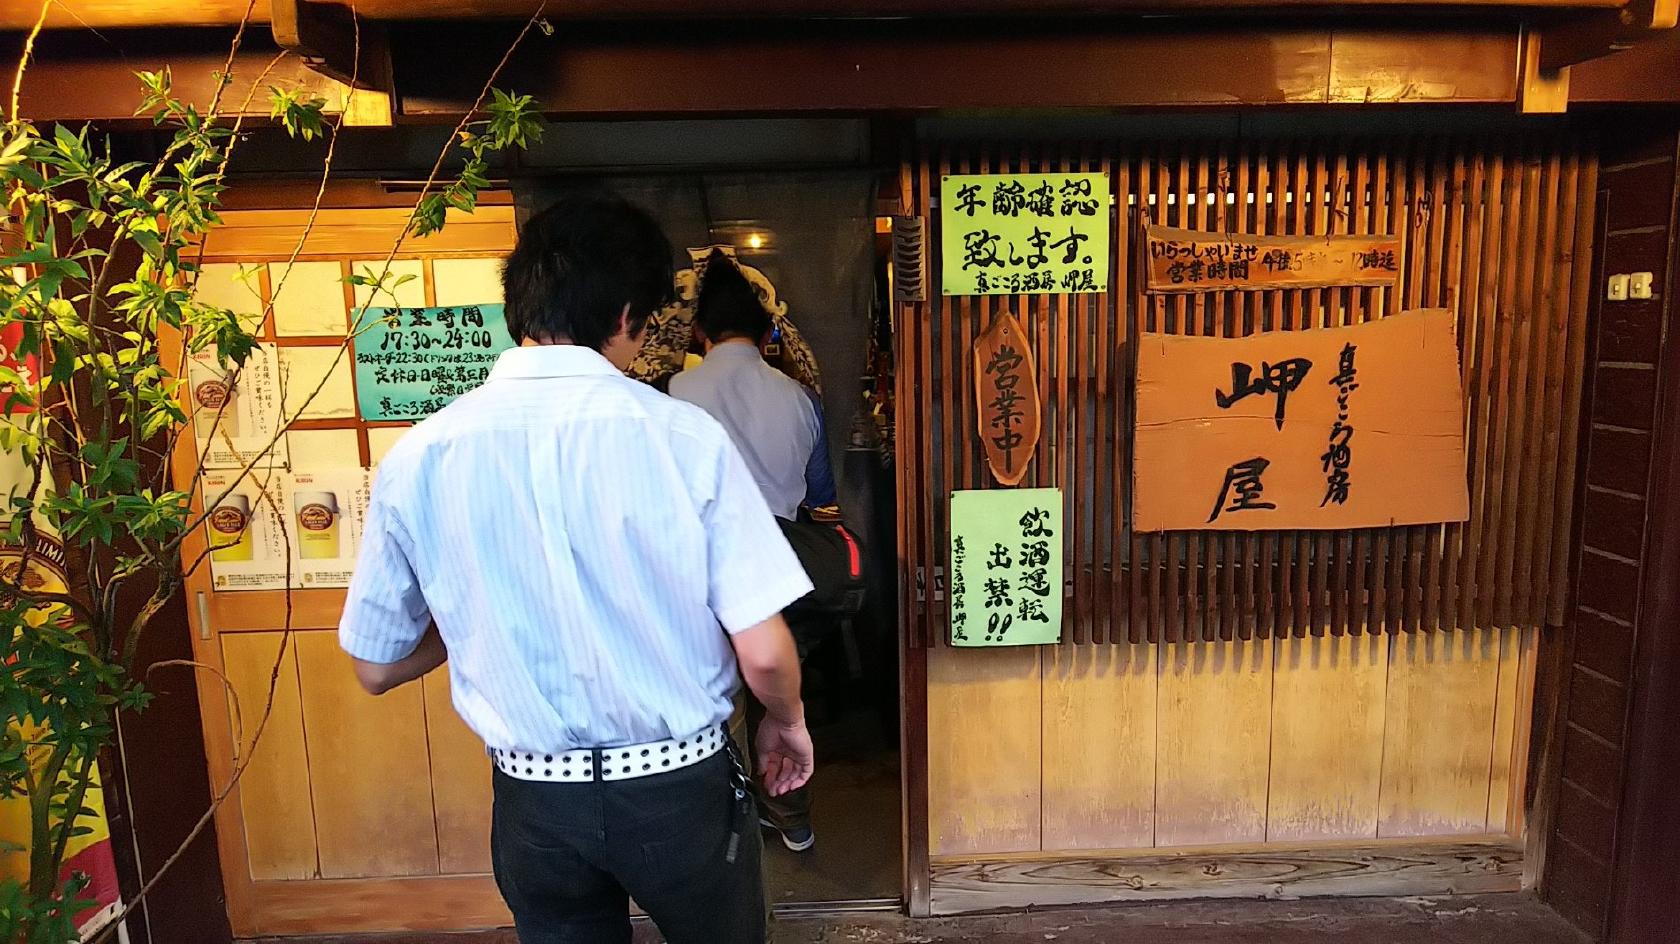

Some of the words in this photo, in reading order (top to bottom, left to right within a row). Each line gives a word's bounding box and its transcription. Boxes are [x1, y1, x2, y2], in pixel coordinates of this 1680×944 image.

[954, 179, 1100, 217] 年齢確認
[962, 226, 1093, 271] 致します。
[1151, 241, 1259, 262] いらっしゃいませ
[1166, 260, 1250, 284] 営業時間
[383, 306, 485, 329] 営業時間
[985, 344, 1025, 474] 営業中
[1205, 356, 1313, 524] 岬屋
[1017, 507, 1054, 623] 飲酒運転
